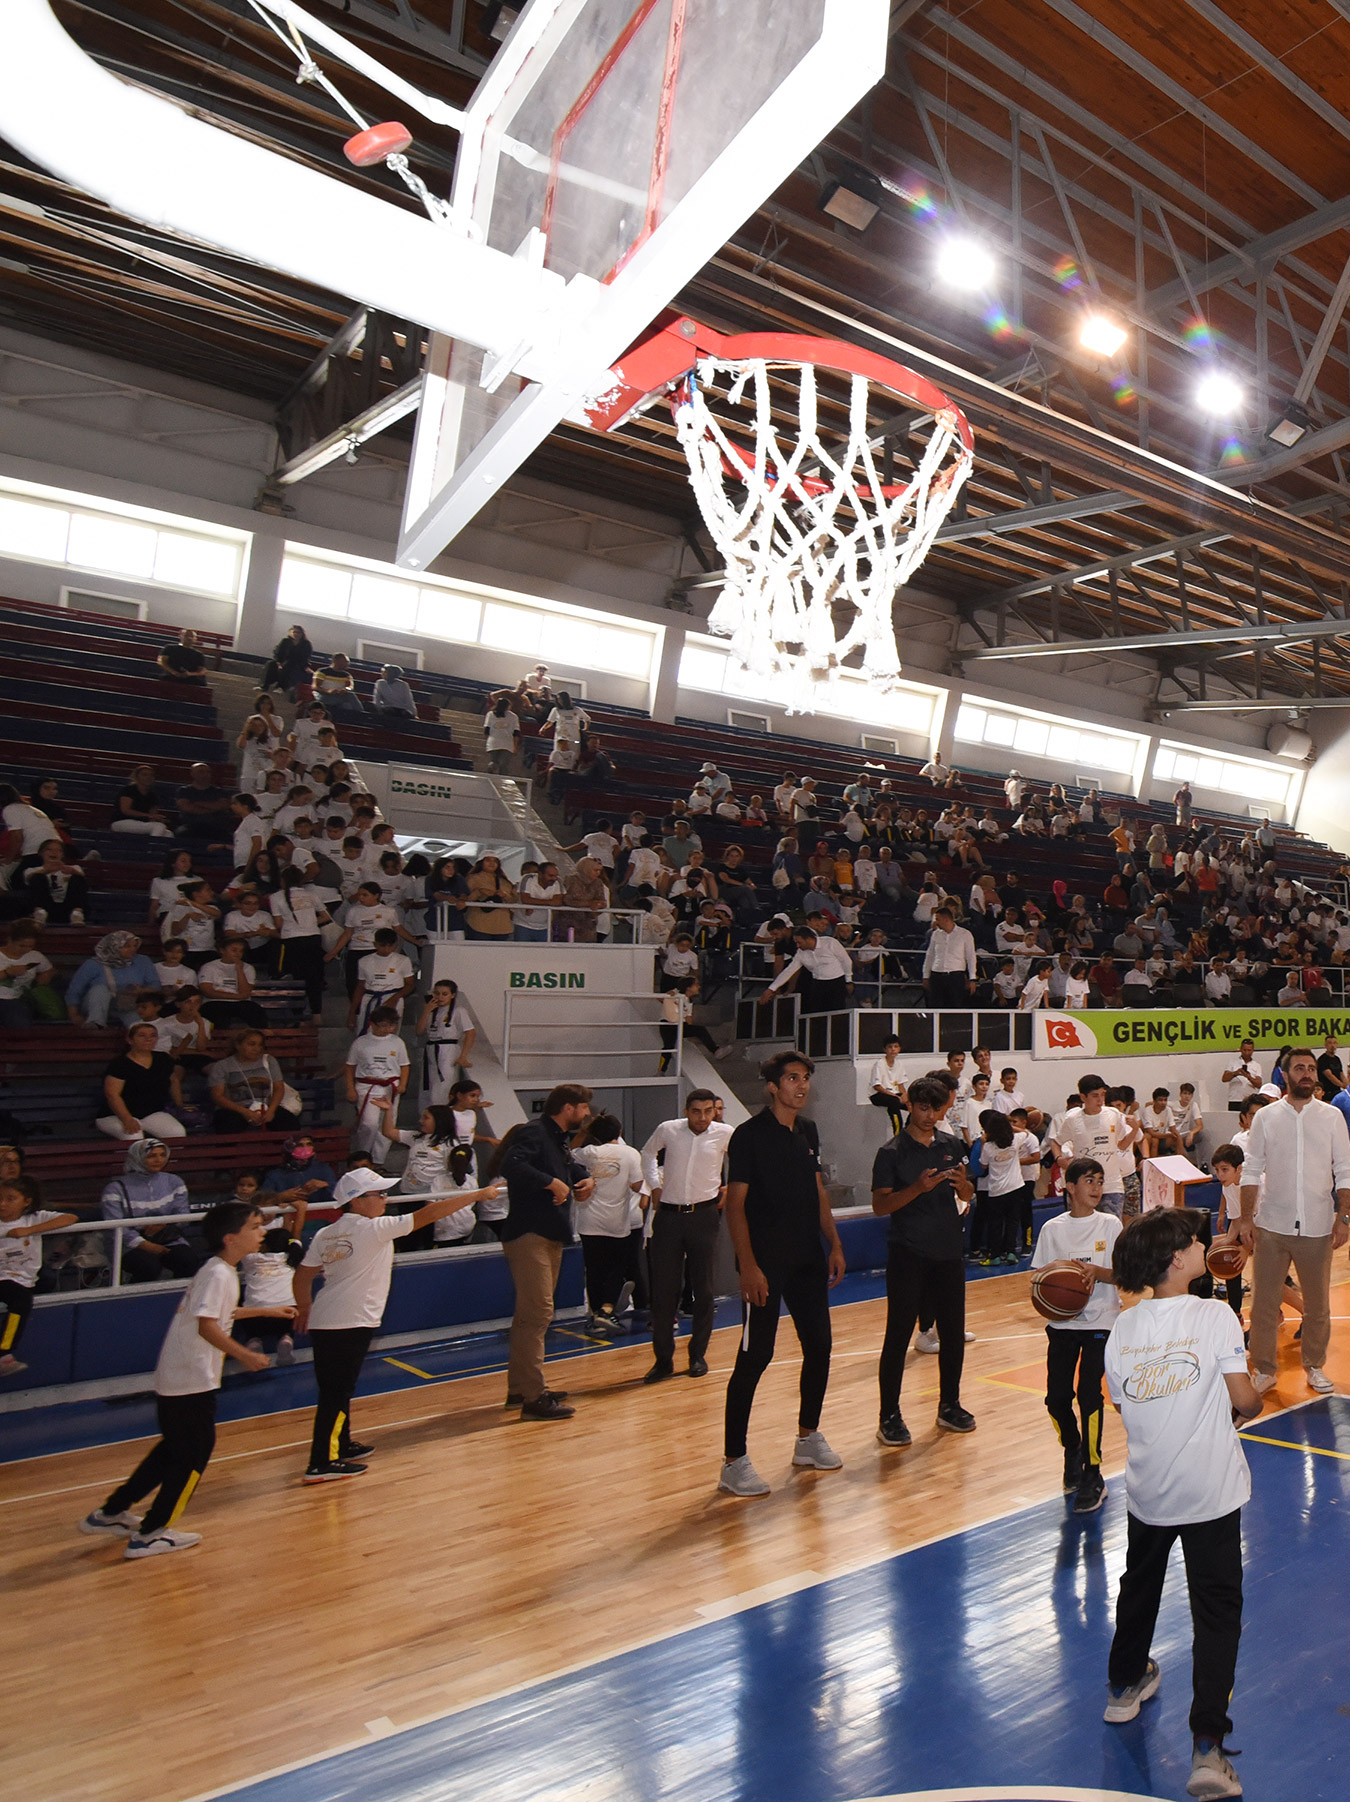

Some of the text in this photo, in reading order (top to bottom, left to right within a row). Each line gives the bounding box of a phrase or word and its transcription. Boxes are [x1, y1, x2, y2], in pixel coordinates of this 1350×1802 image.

[391, 780, 452, 799] BASIN
[510, 972, 585, 989] BASIN
[1113, 1015, 1216, 1047] GENÇLİK
[1222, 1025, 1242, 1039] VE
[1248, 1018, 1301, 1039] SPOR
[1130, 1363, 1171, 1386] Spor
